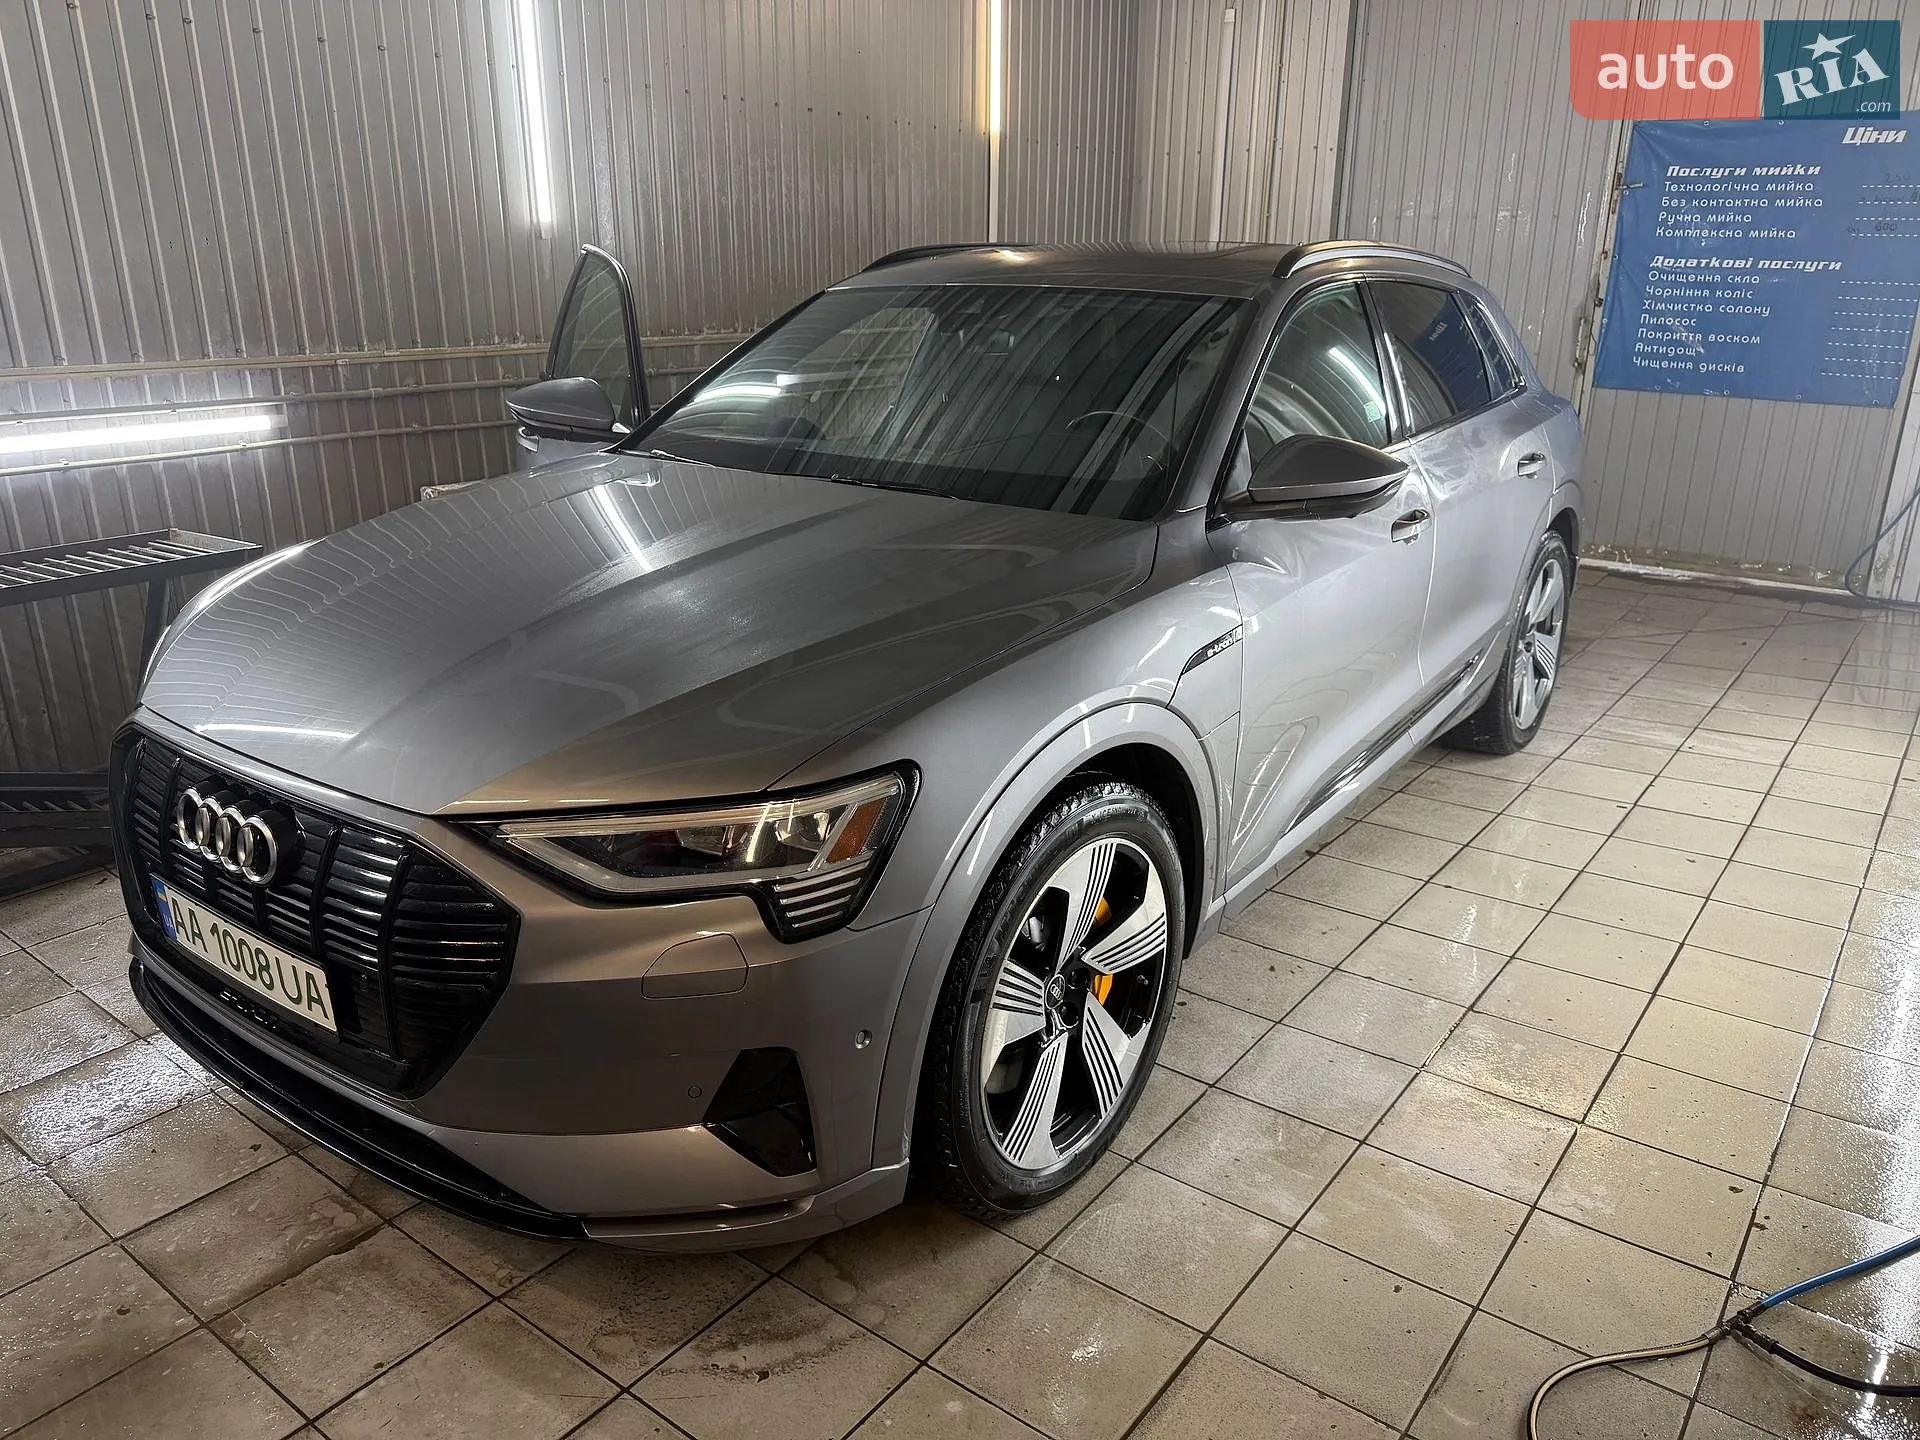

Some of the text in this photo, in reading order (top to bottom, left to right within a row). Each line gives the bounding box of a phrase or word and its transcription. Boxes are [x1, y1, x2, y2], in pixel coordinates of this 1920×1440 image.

[1842, 127, 1907, 145] Ціни
[1666, 164, 1821, 179] Послуги мийки
[1664, 181, 1814, 192] Технологічна мийка
[1661, 196, 1823, 207] Без контактна мийка
[1658, 211, 1752, 224] Ручна мийка
[1656, 227, 1796, 239] Комплексна мийка
[1649, 255, 1843, 272] Додаткові послуги
[1648, 271, 1760, 284] Очищення скла
[1646, 285, 1753, 299] Чорніння коліс
[1642, 300, 1771, 317] Хімчистка салону
[1640, 314, 1697, 326] Пилосос
[1637, 328, 1761, 344] Покриття воском
[1635, 342, 1696, 357] Антидощ
[1633, 356, 1745, 373] Чищення дисків
[171, 897, 208, 953] AA
[209, 922, 274, 991] 1008
[275, 956, 329, 1020] UA
